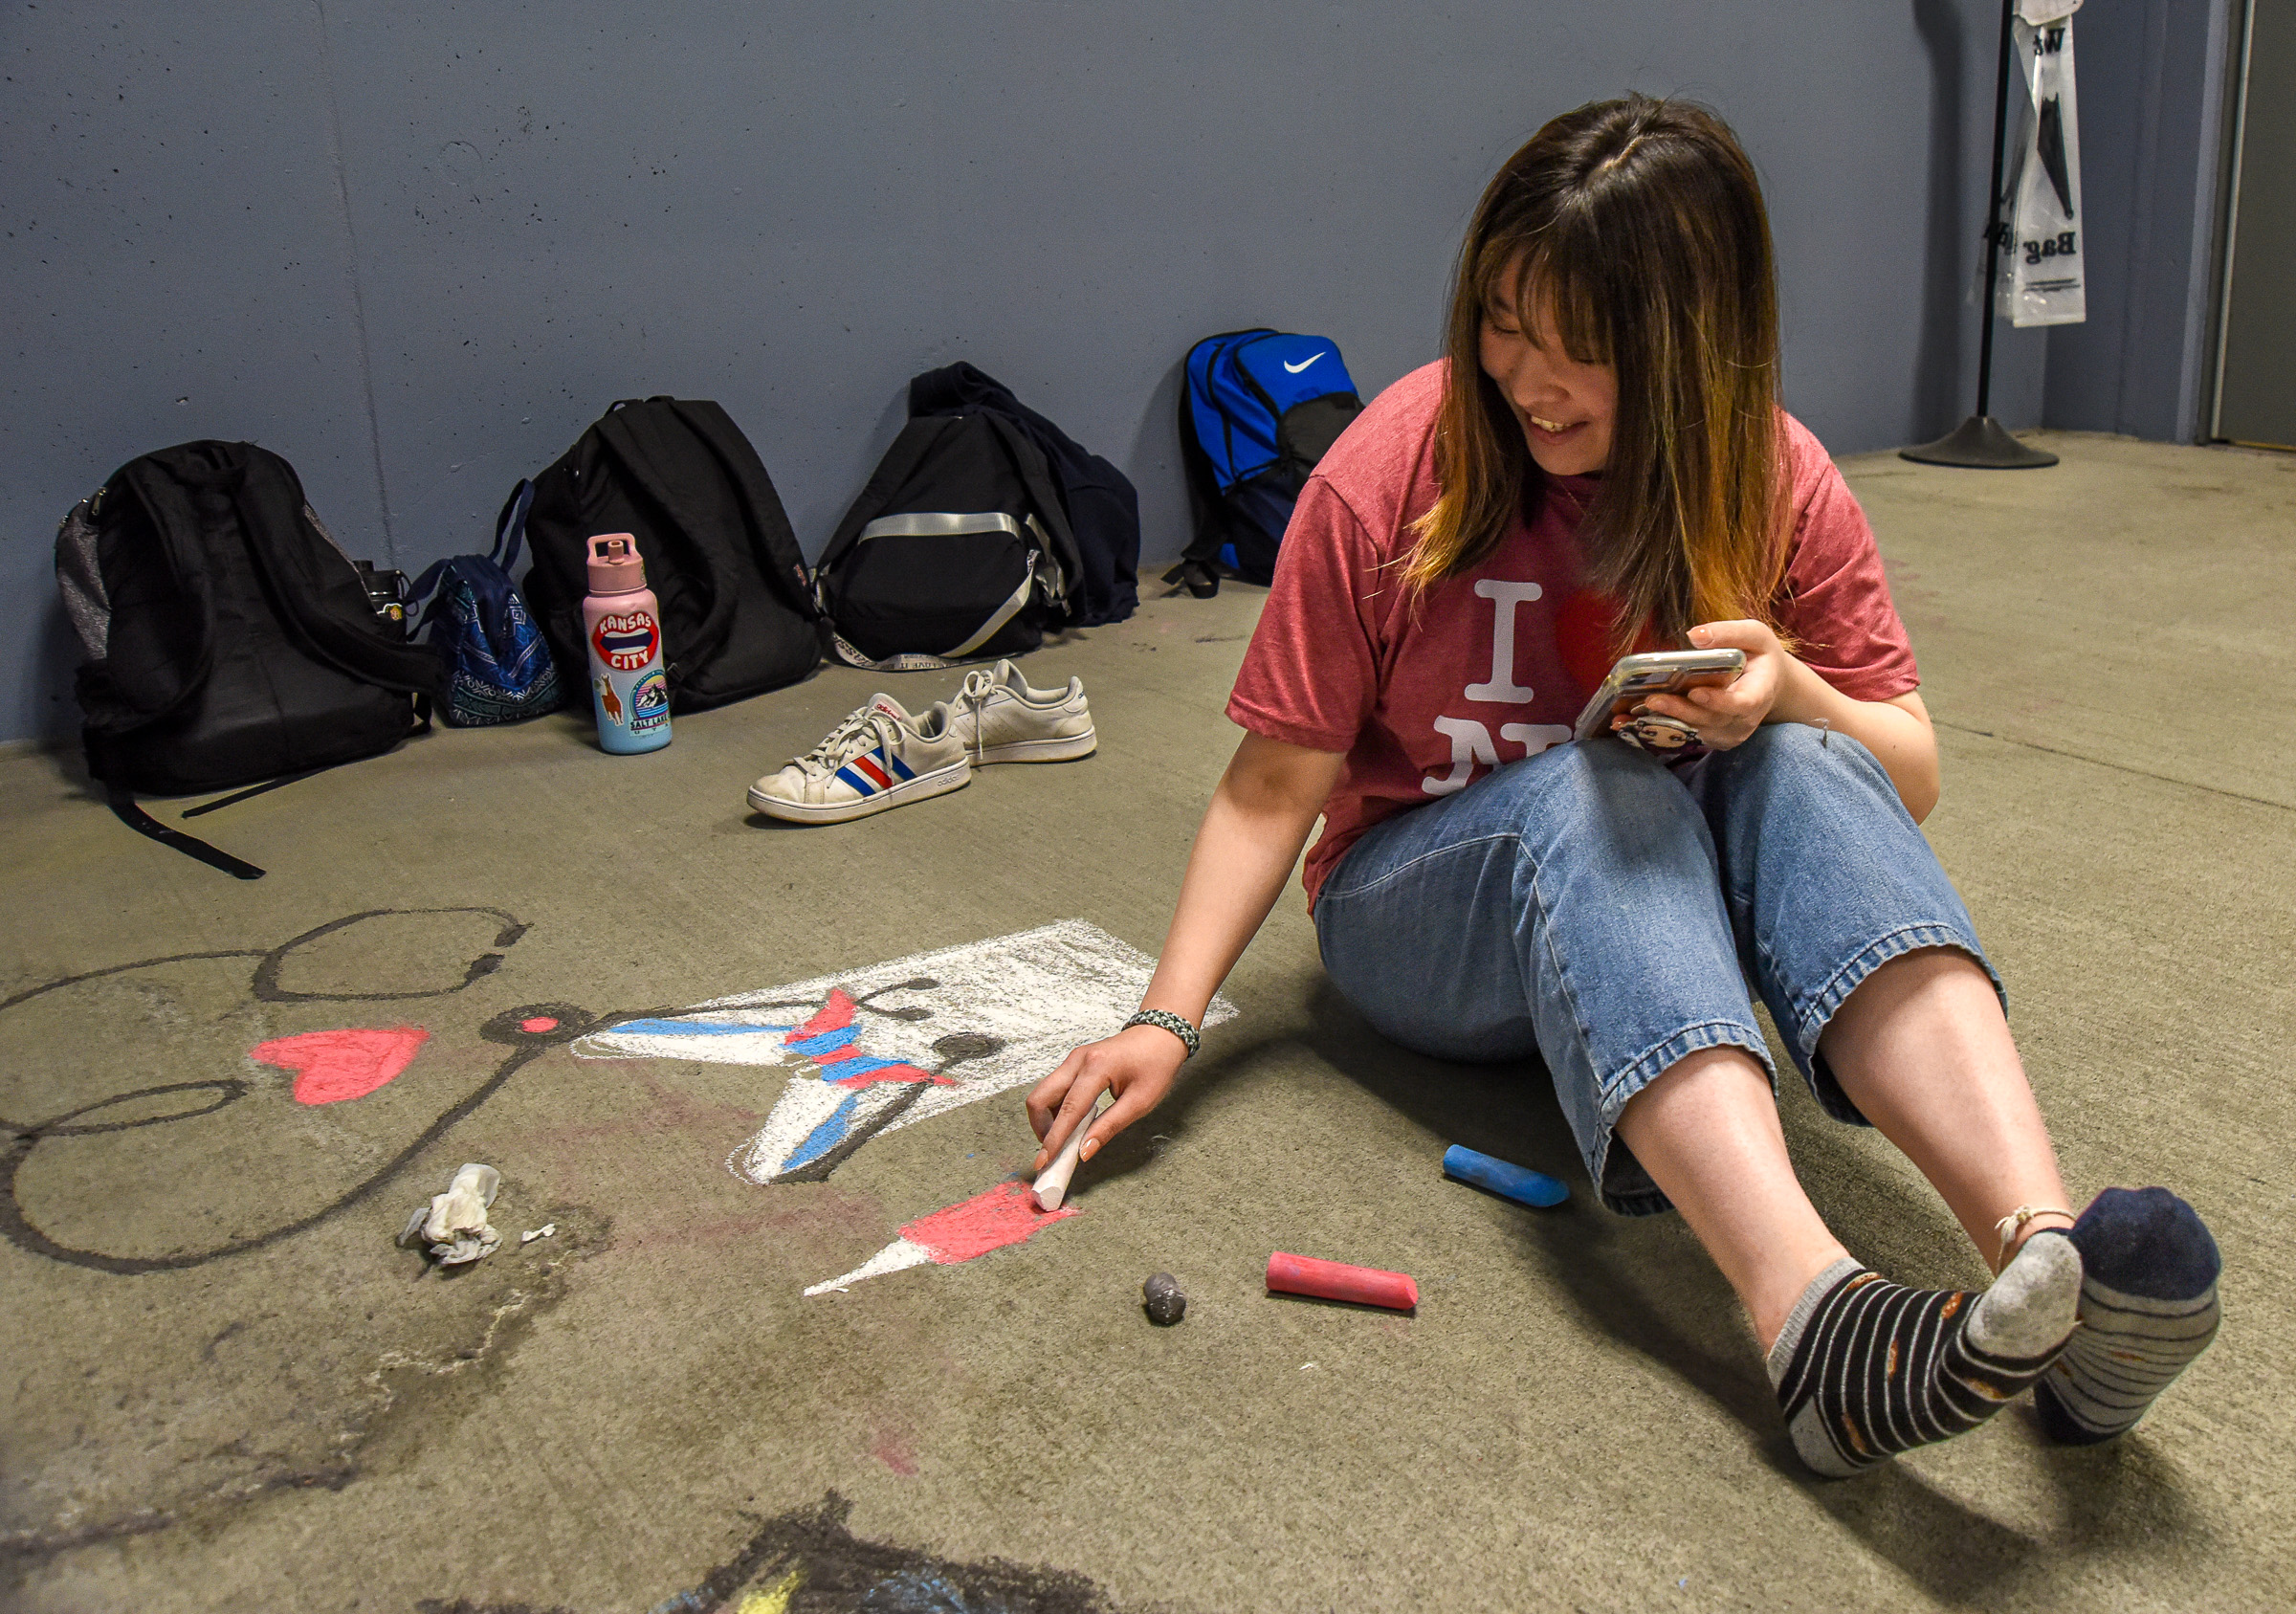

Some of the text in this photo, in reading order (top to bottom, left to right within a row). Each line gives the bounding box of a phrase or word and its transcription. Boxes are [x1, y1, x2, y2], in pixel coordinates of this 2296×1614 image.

[599, 612, 651, 633] KANSAS
[1464, 579, 1542, 703] I
[610, 650, 649, 669] CITY
[629, 715, 668, 729] SALT LAKE
[1422, 715, 1573, 796] N
